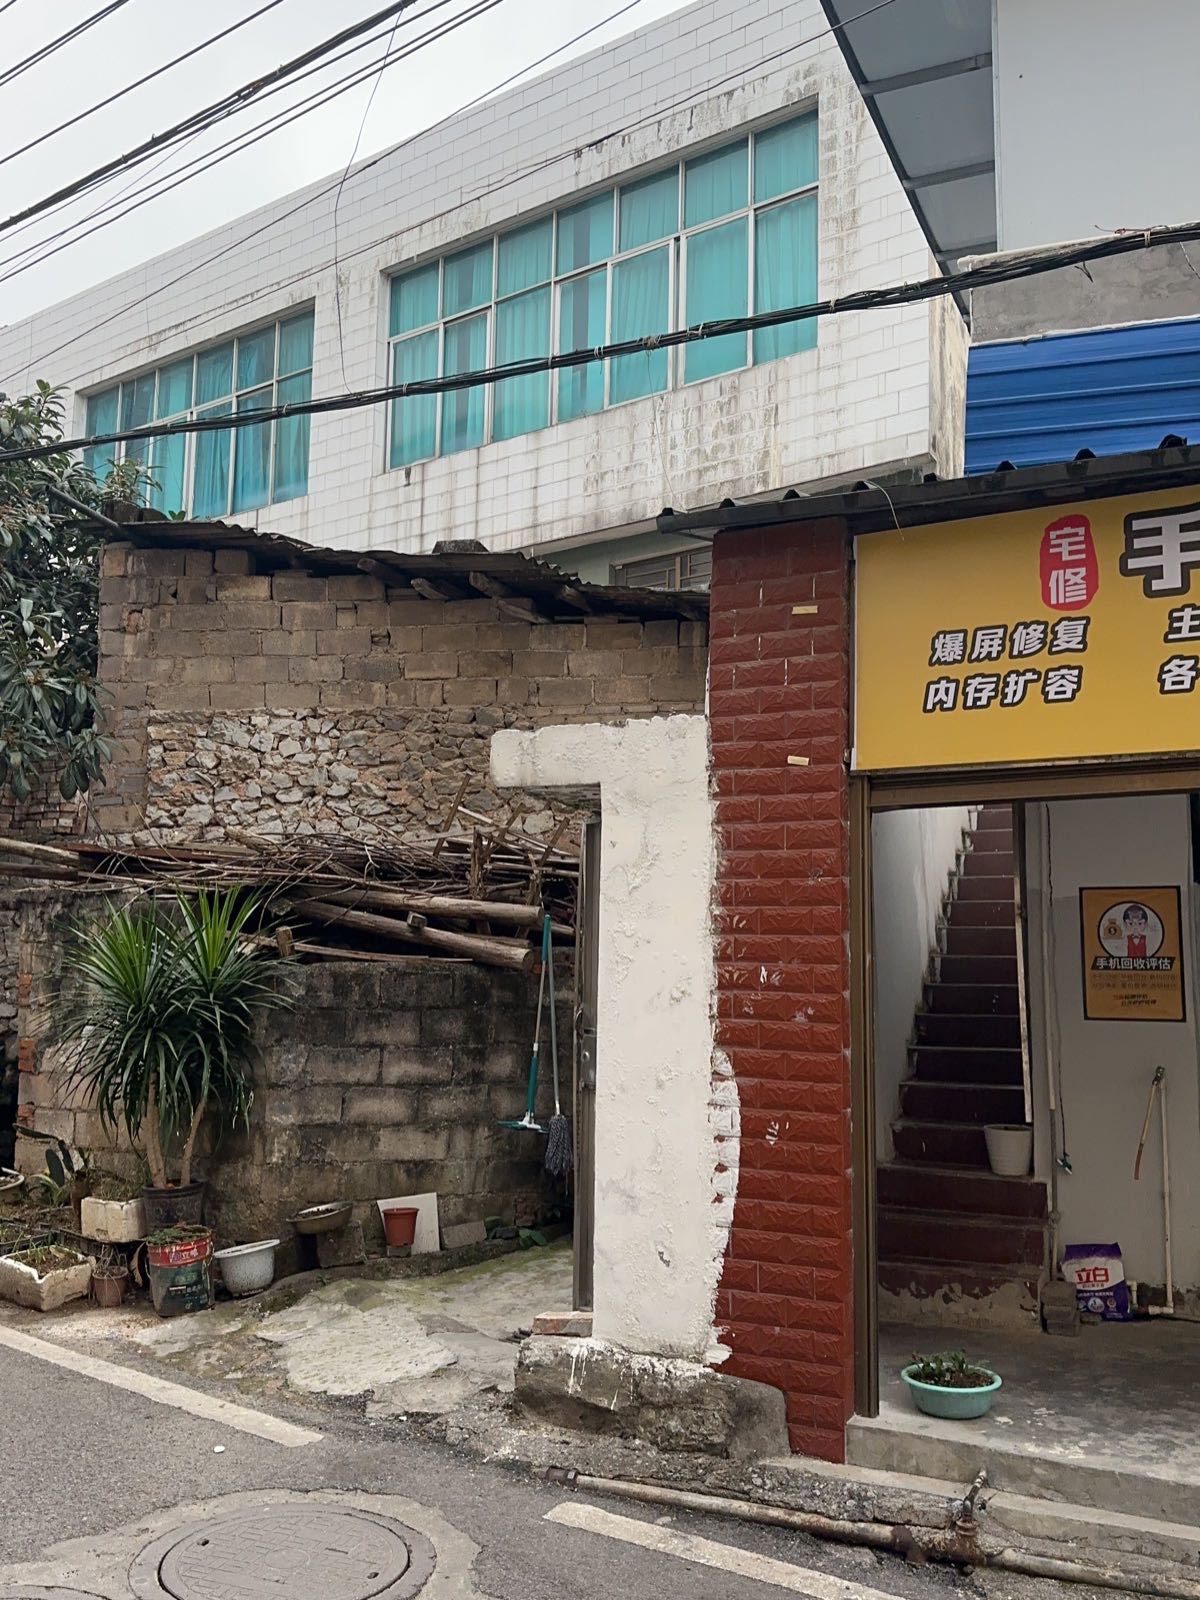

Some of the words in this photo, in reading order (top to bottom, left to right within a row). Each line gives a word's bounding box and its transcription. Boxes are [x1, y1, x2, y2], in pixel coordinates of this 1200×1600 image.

[1048, 526, 1088, 605] 宅修
[1125, 506, 1200, 594] 手
[931, 618, 1089, 664] 爆屏修复
[1166, 606, 1200, 641] 主
[924, 667, 1081, 711] 内存扩容
[1160, 657, 1198, 692] 各
[1096, 958, 1171, 970] 手机回收评估
[1075, 1267, 1109, 1284] 立白
